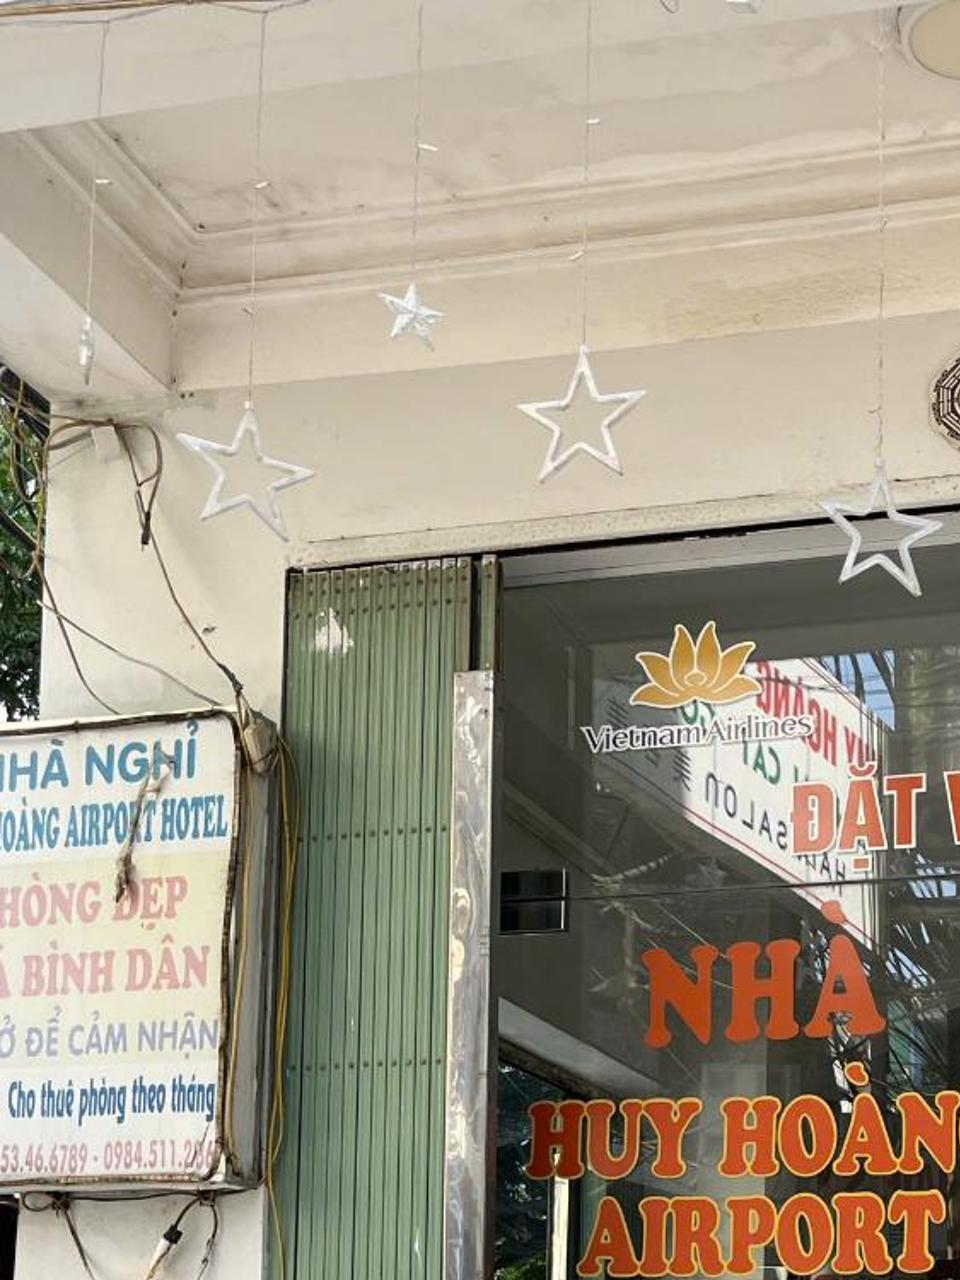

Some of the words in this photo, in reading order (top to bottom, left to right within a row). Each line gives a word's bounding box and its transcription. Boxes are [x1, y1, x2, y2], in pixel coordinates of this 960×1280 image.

[0, 738, 69, 793] HÀ
[85, 720, 198, 786] NGHỈ
[580, 721, 703, 754] Vietnam
[706, 713, 814, 745] Airlines
[0, 797, 60, 853] OÀNG
[160, 794, 228, 842] HOTEL
[788, 762, 927, 874] ĐẶT
[21, 940, 116, 997] BÌNH
[124, 933, 210, 992] DÂN
[641, 900, 887, 1050] NHÀ
[25, 1005, 62, 1058] ĐỂ
[68, 1010, 128, 1055] CẢM
[138, 1011, 219, 1060] NHẬN
[8, 1080, 36, 1119] Cho
[41, 1079, 74, 1118] thuê
[78, 1076, 127, 1127] phòng
[132, 1075, 166, 1114] theo
[171, 1074, 216, 1123] tháng
[525, 1096, 703, 1181] HUY
[576, 1189, 947, 1279] AIRPORT
